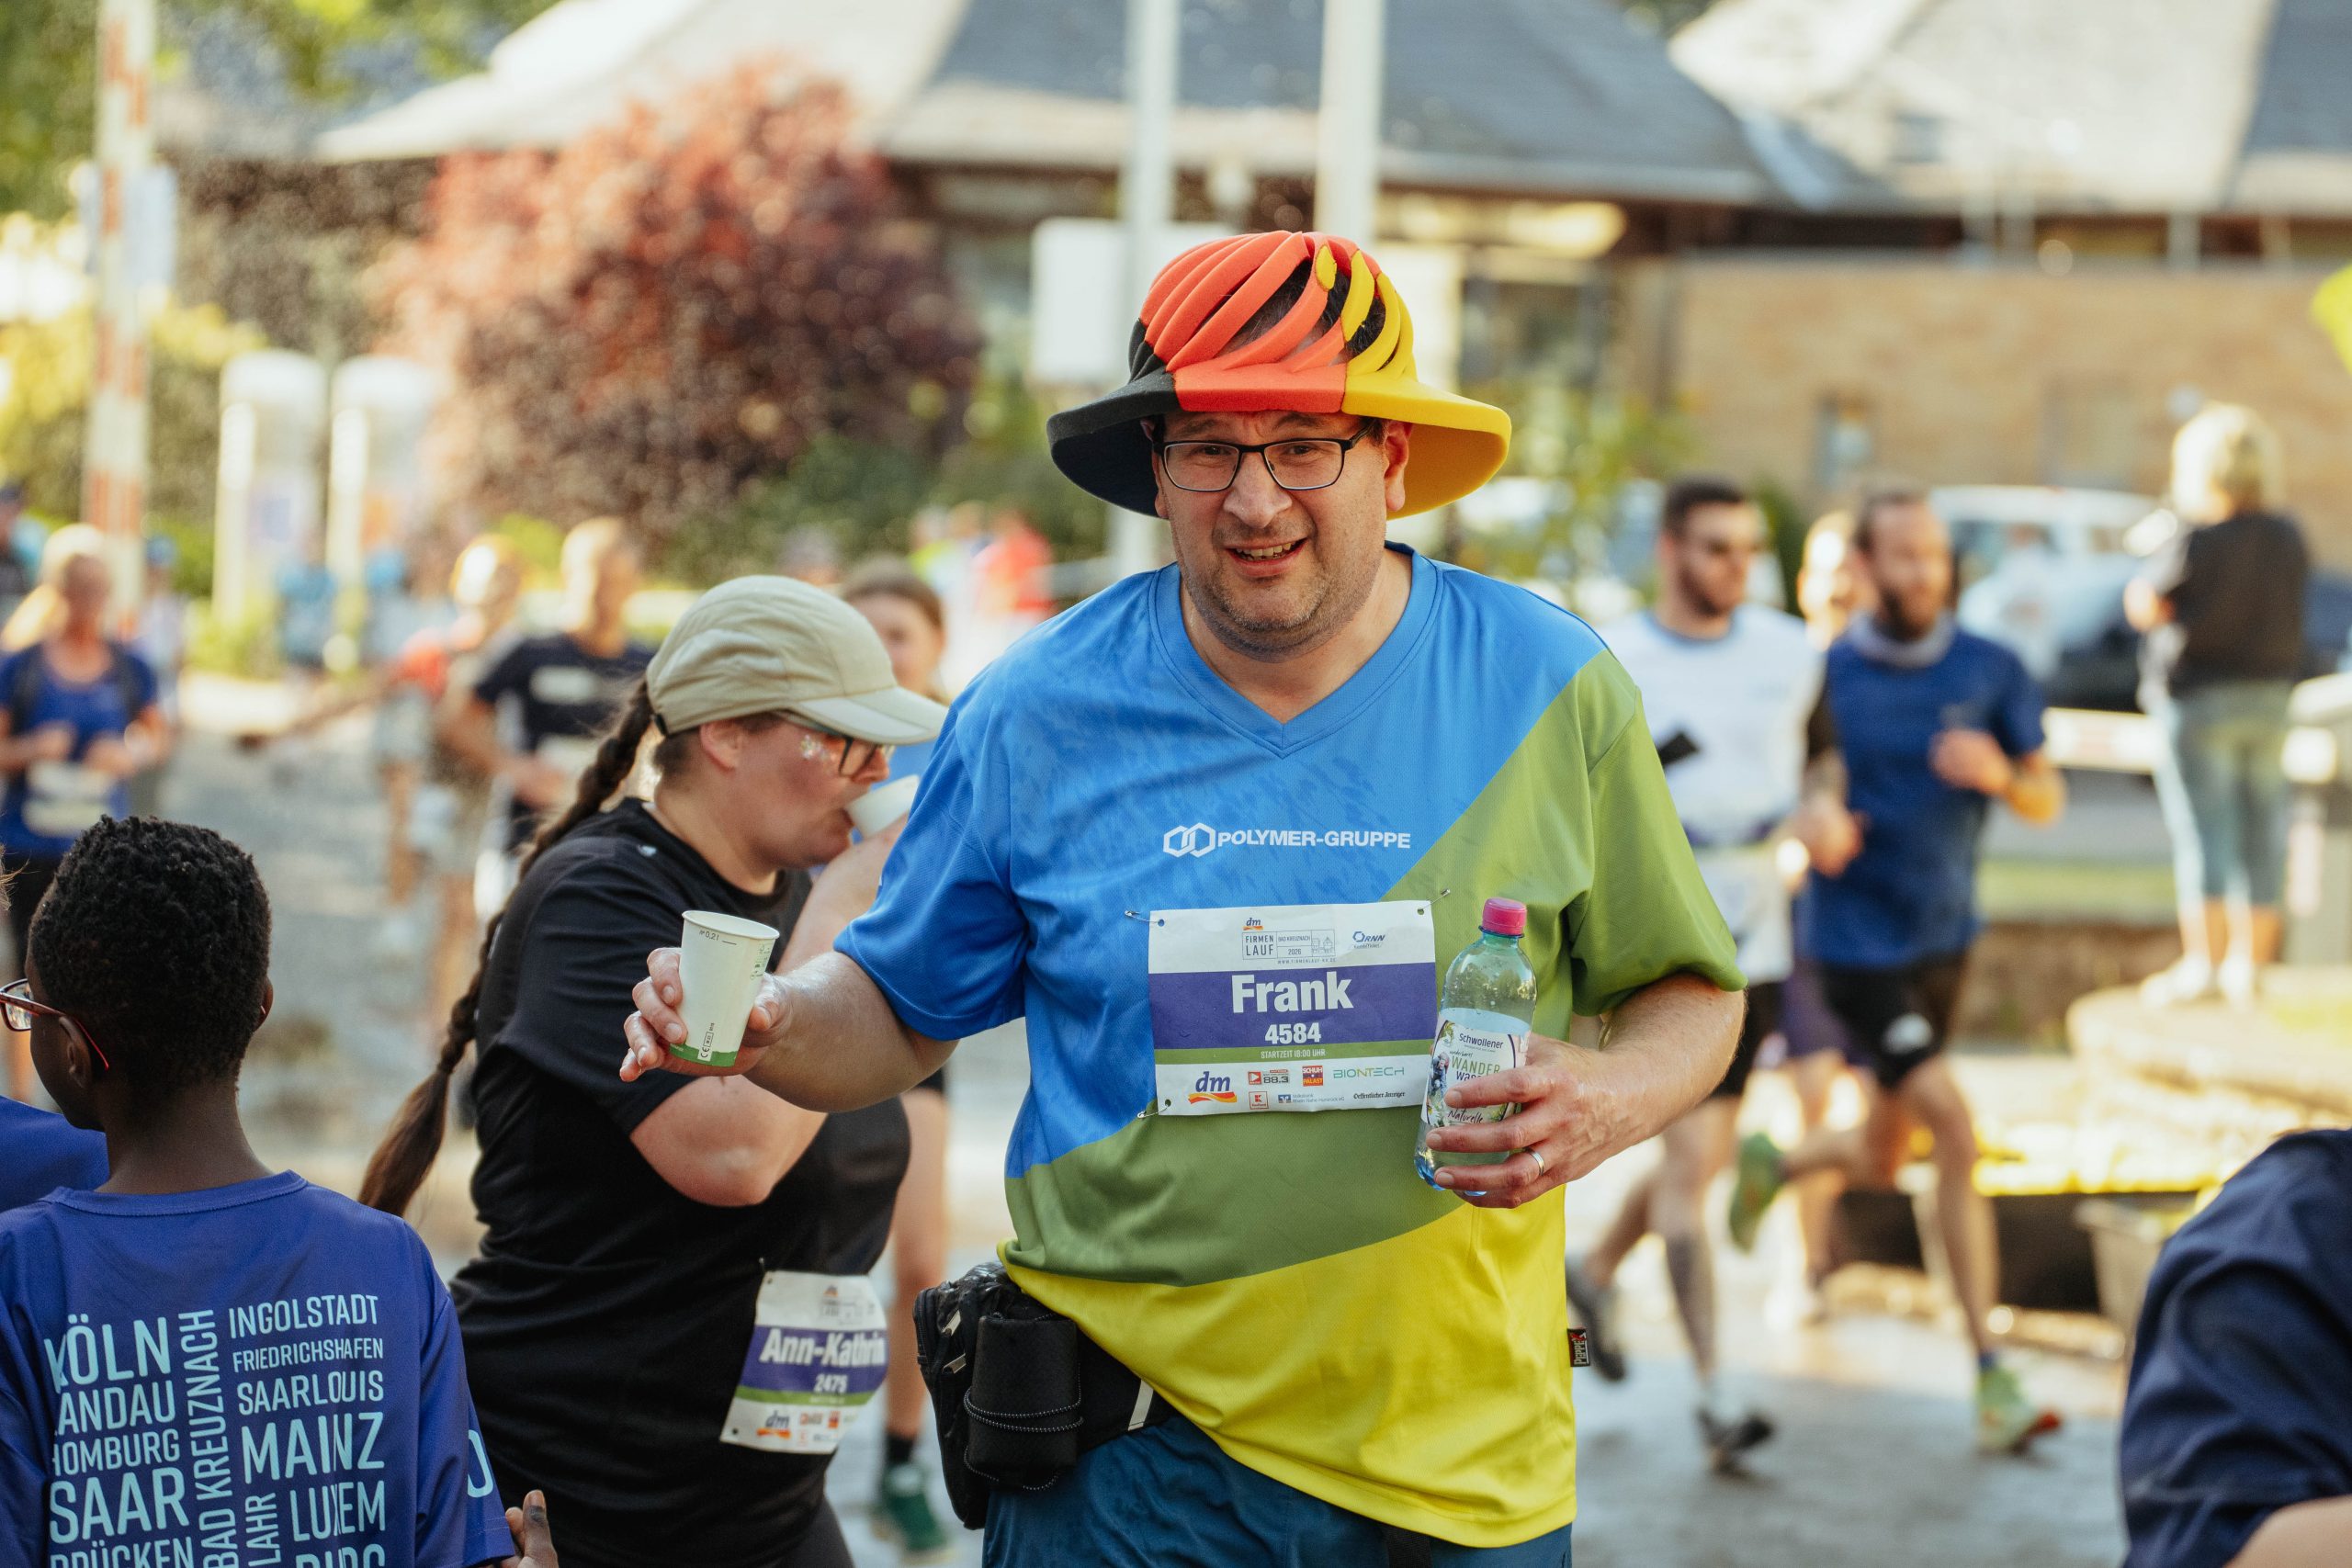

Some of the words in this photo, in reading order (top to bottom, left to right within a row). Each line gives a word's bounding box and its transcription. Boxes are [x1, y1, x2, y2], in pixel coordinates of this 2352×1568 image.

[1218, 829, 1411, 849] POLYMER-GRUPPE
[1245, 934, 1274, 943] FIRMEN
[1245, 944, 1274, 956] LAUF
[1231, 971, 1354, 1014] Frank
[1264, 1022, 1322, 1044] 4584
[1459, 1032, 1504, 1049] Schwollener
[1261, 1050, 1293, 1059] STARTZEIT
[1294, 1049, 1311, 1057] 18:00
[1312, 1048, 1326, 1057] UHR
[1452, 1055, 1500, 1076] WANDER
[1195, 1070, 1231, 1093] dm
[1263, 1076, 1289, 1084] 88.3
[1333, 1066, 1405, 1078] BIONTECH
[1448, 1109, 1484, 1123] Naturelle
[229, 1293, 379, 1339] INGOLSTADT
[43, 1313, 172, 1394] KÖLN
[232, 1337, 384, 1373] FRIEDRICHSHAFEN
[55, 1380, 175, 1437] ANDAU
[177, 1309, 232, 1501] KREUZNACH
[236, 1370, 384, 1416] SAARLOUIS
[241, 1411, 385, 1484] MAINZ
[49, 1466, 190, 1544] SAAR
[289, 1480, 385, 1542] LUXEM
[198, 1507, 238, 1568] BAD
[244, 1492, 281, 1567] LAHR
